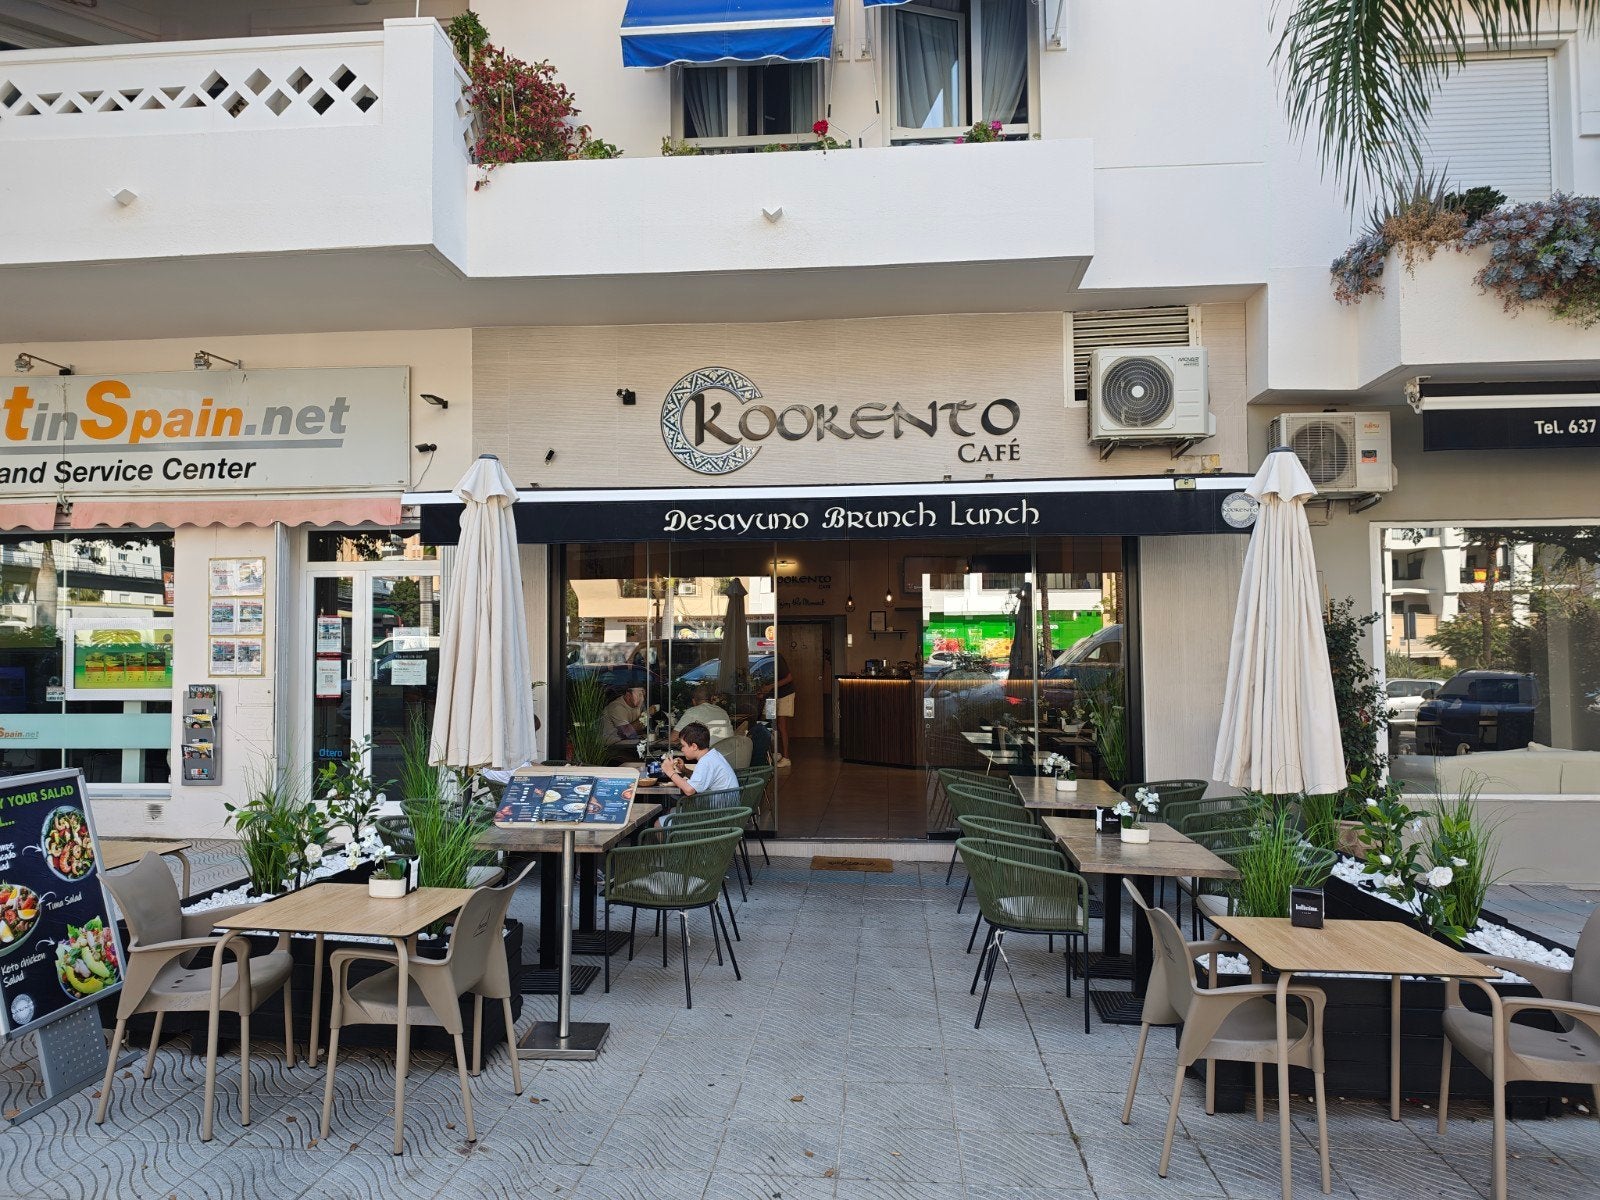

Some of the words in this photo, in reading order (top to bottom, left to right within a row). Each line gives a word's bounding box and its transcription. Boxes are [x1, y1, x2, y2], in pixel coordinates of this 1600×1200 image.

[690, 393, 1021, 447] KOOKENTO
[1534, 420, 1564, 435] Tel.
[1568, 419, 1597, 434] 637
[958, 438, 1020, 463] CAFÉ
[0, 461, 47, 484] and
[54, 458, 153, 485] Service
[162, 456, 257, 481] Center
[663, 509, 809, 535] Desayuno
[951, 499, 1040, 526] Lunch
[776, 575, 832, 584] OOKENTO
[319, 748, 343, 757] Otero
[7, 791, 38, 807] YOUR
[40, 785, 74, 801] SALAD
[65, 892, 83, 906] Salad
[1, 963, 20, 975] Keto
[2, 971, 25, 988] Salad
